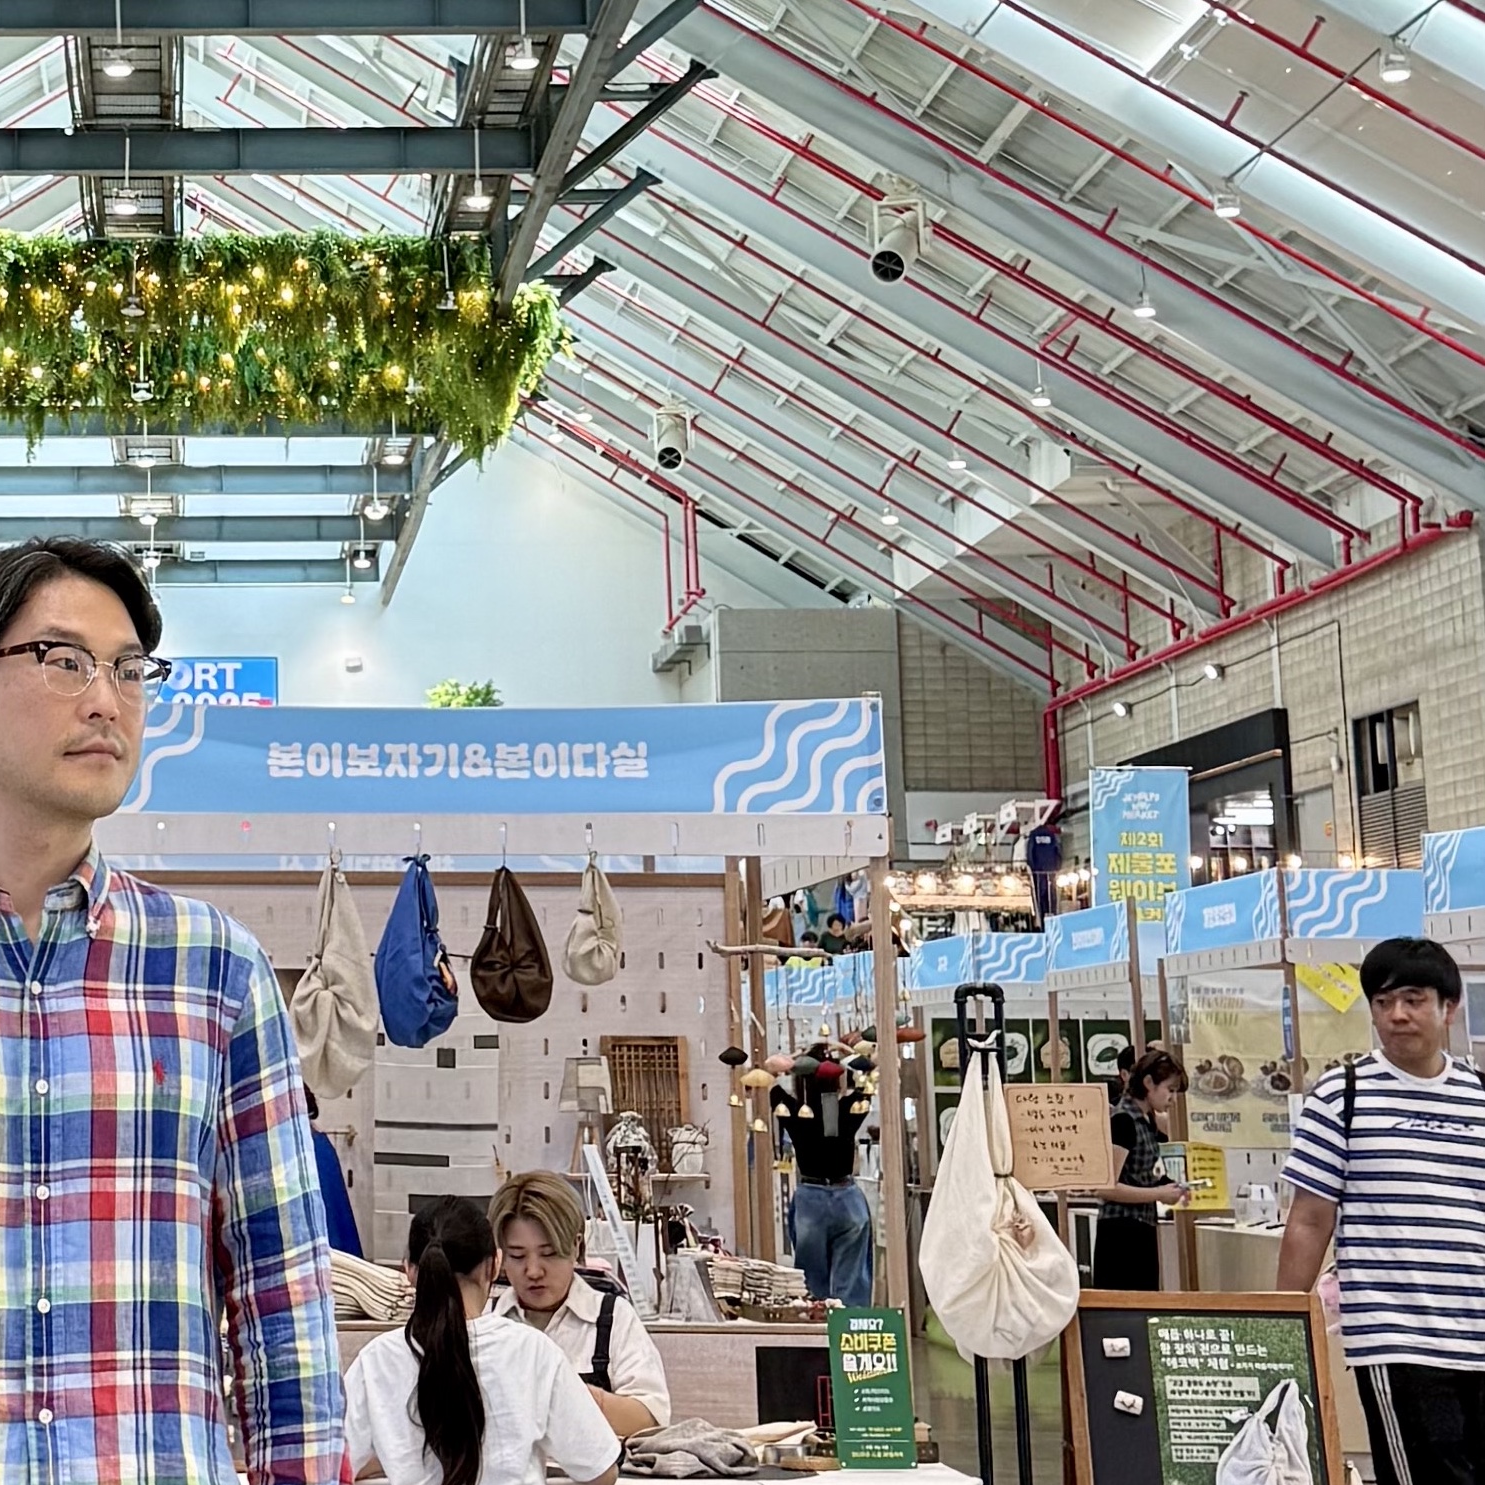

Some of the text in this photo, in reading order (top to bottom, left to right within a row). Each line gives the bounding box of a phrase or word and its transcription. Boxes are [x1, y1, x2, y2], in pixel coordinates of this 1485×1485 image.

[266, 740, 650, 780] 본이보자기&본이다실
[1120, 832, 1163, 848] 제2회
[1108, 853, 1177, 874] 제물포
[840, 1332, 897, 1352] 소비쿠폰
